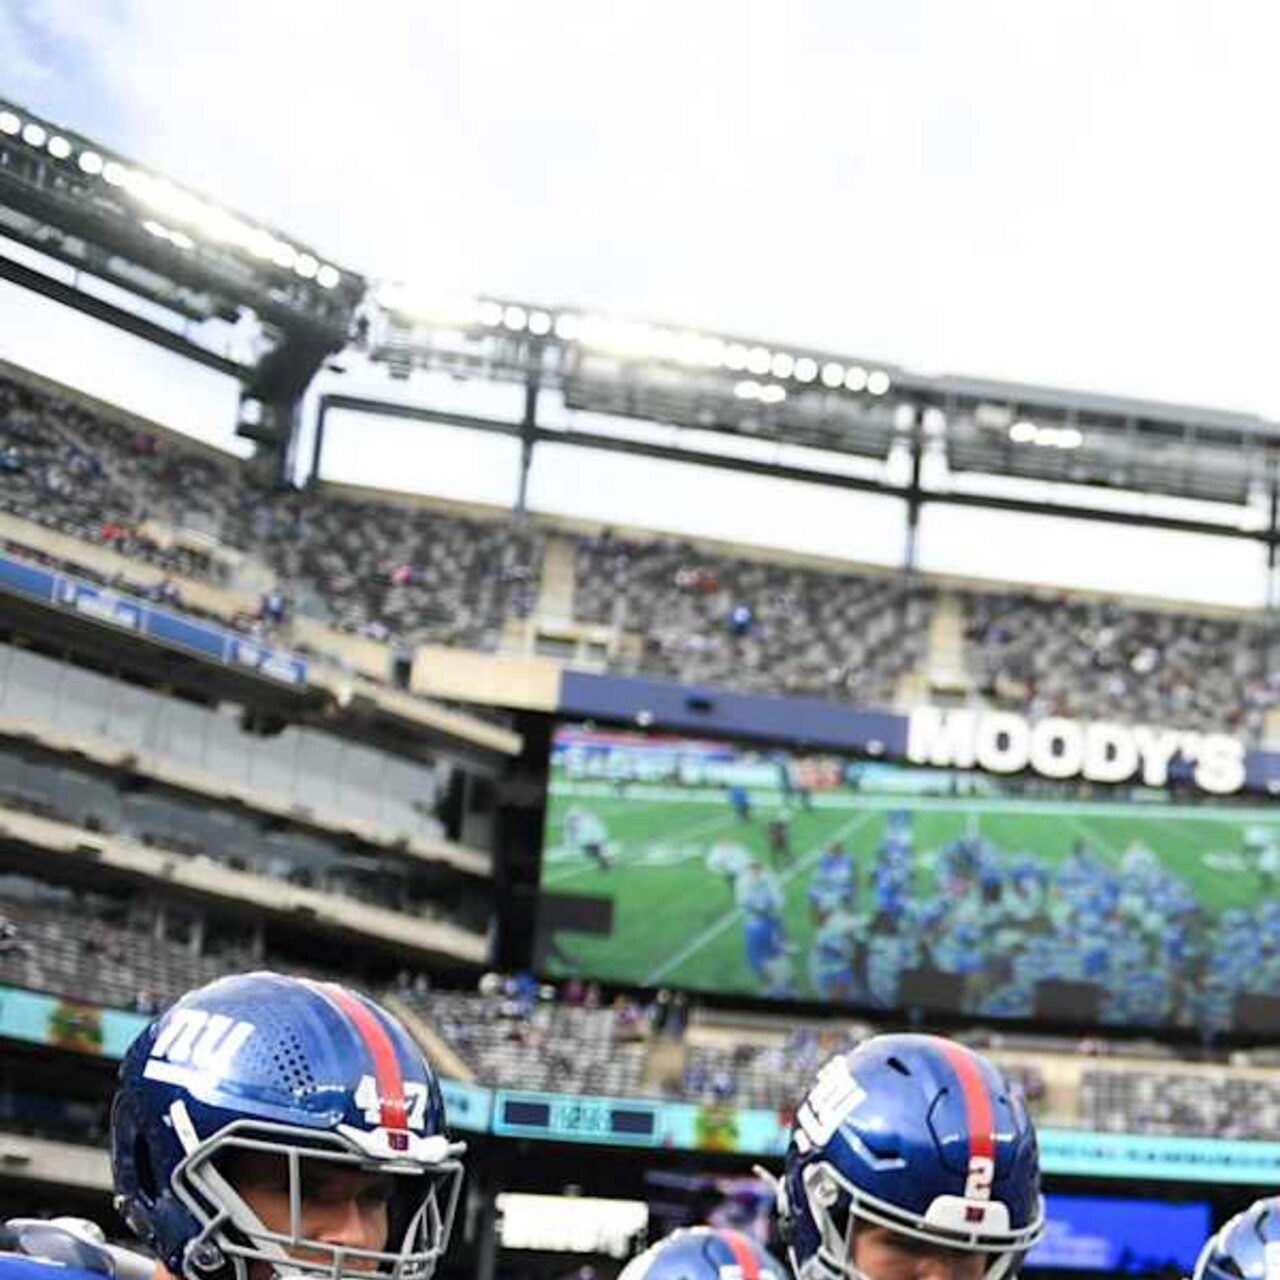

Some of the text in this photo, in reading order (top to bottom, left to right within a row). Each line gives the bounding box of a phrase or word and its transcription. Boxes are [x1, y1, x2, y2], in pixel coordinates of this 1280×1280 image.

[906, 705, 1247, 794] MOODY'S
[354, 1073, 429, 1130] 47
[964, 1157, 995, 1201] 2
